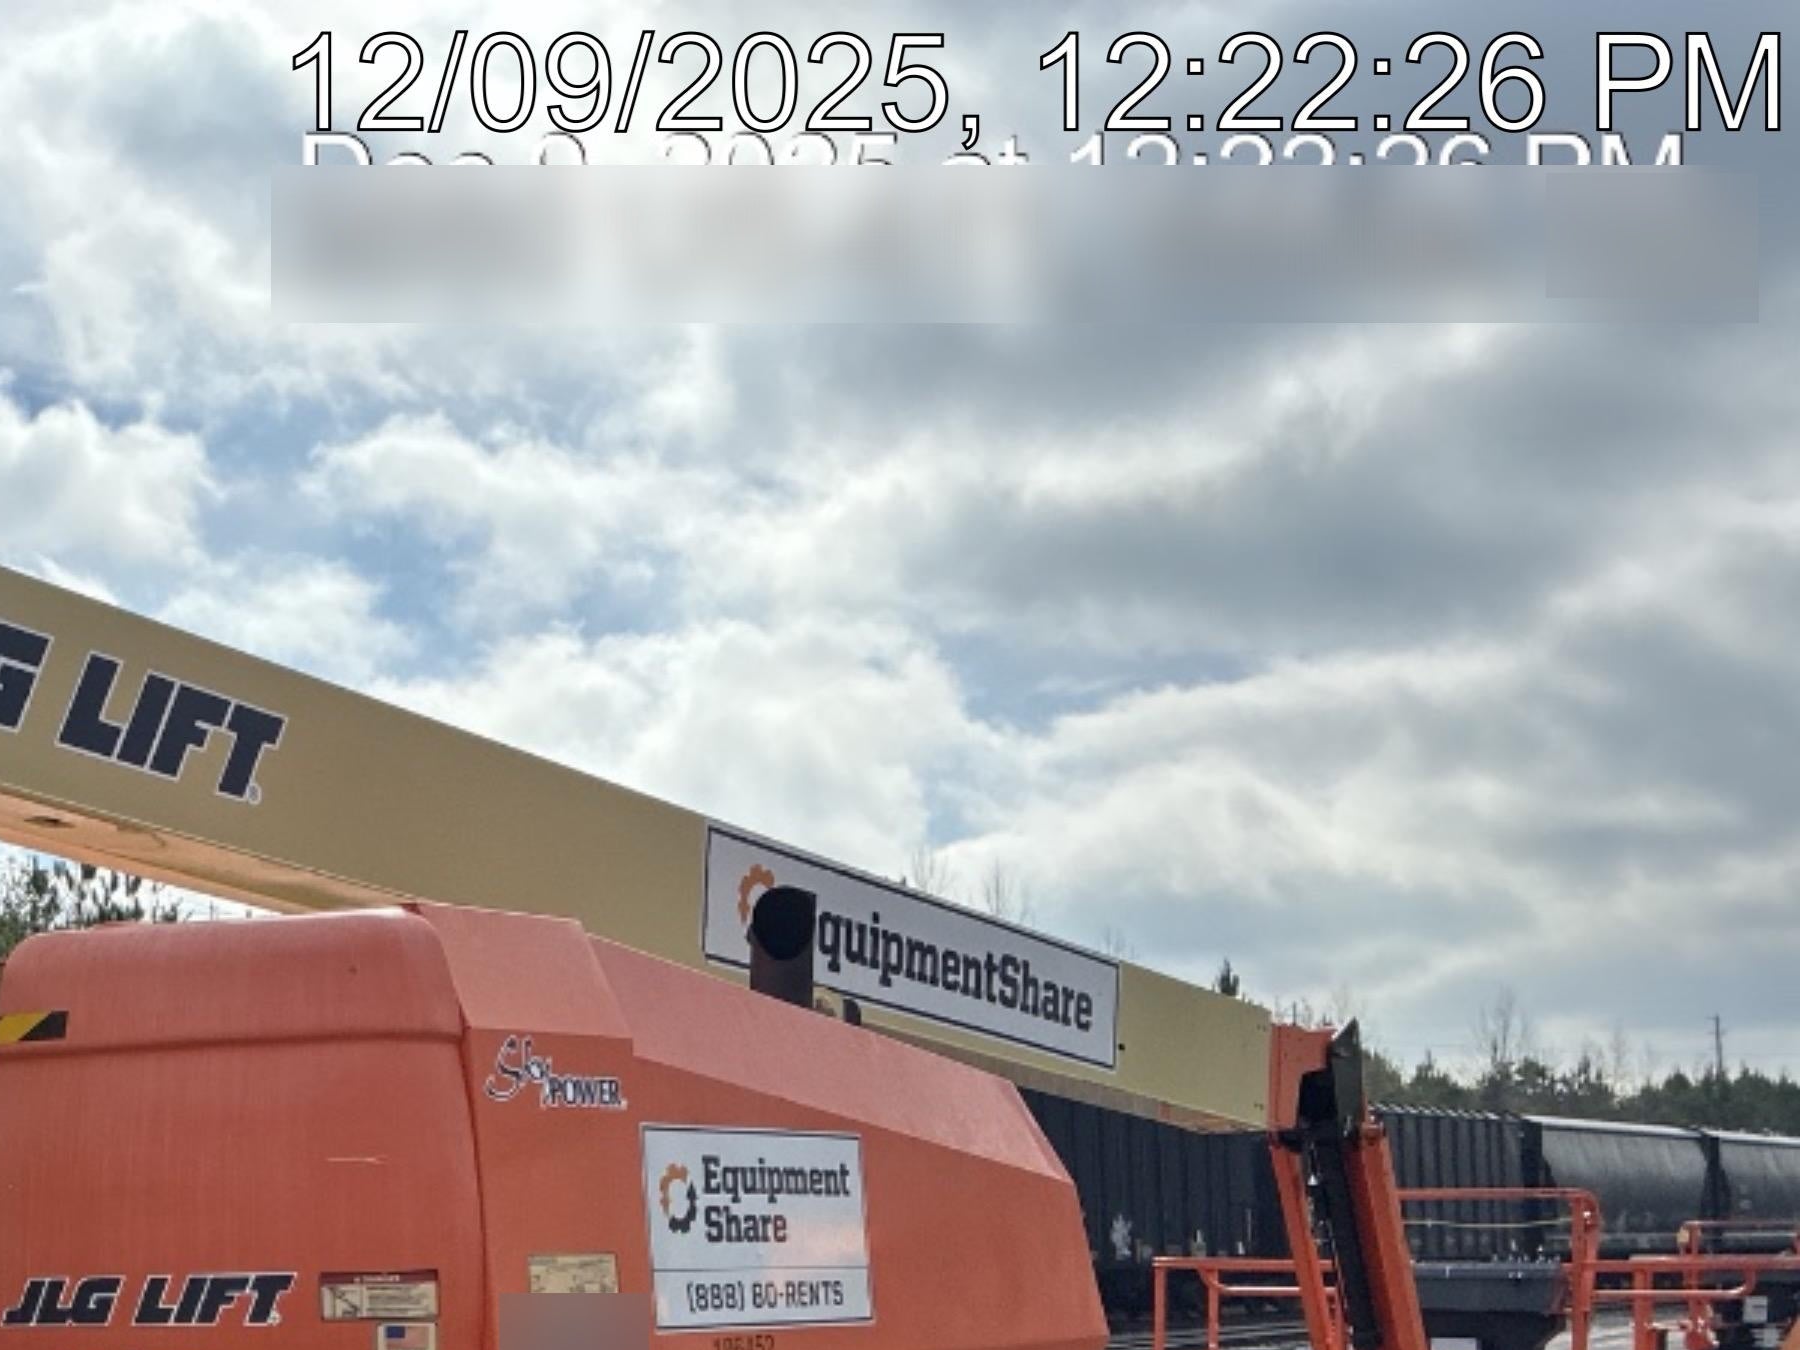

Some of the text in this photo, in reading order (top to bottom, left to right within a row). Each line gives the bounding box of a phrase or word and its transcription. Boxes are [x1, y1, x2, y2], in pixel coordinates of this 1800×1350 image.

[55, 650, 288, 800] LIFT
[816, 908, 1094, 1032] quipmentShare
[701, 1154, 851, 1204] Equipment
[704, 1206, 788, 1243] Share
[0, 1272, 298, 1327] JLG LIFT
